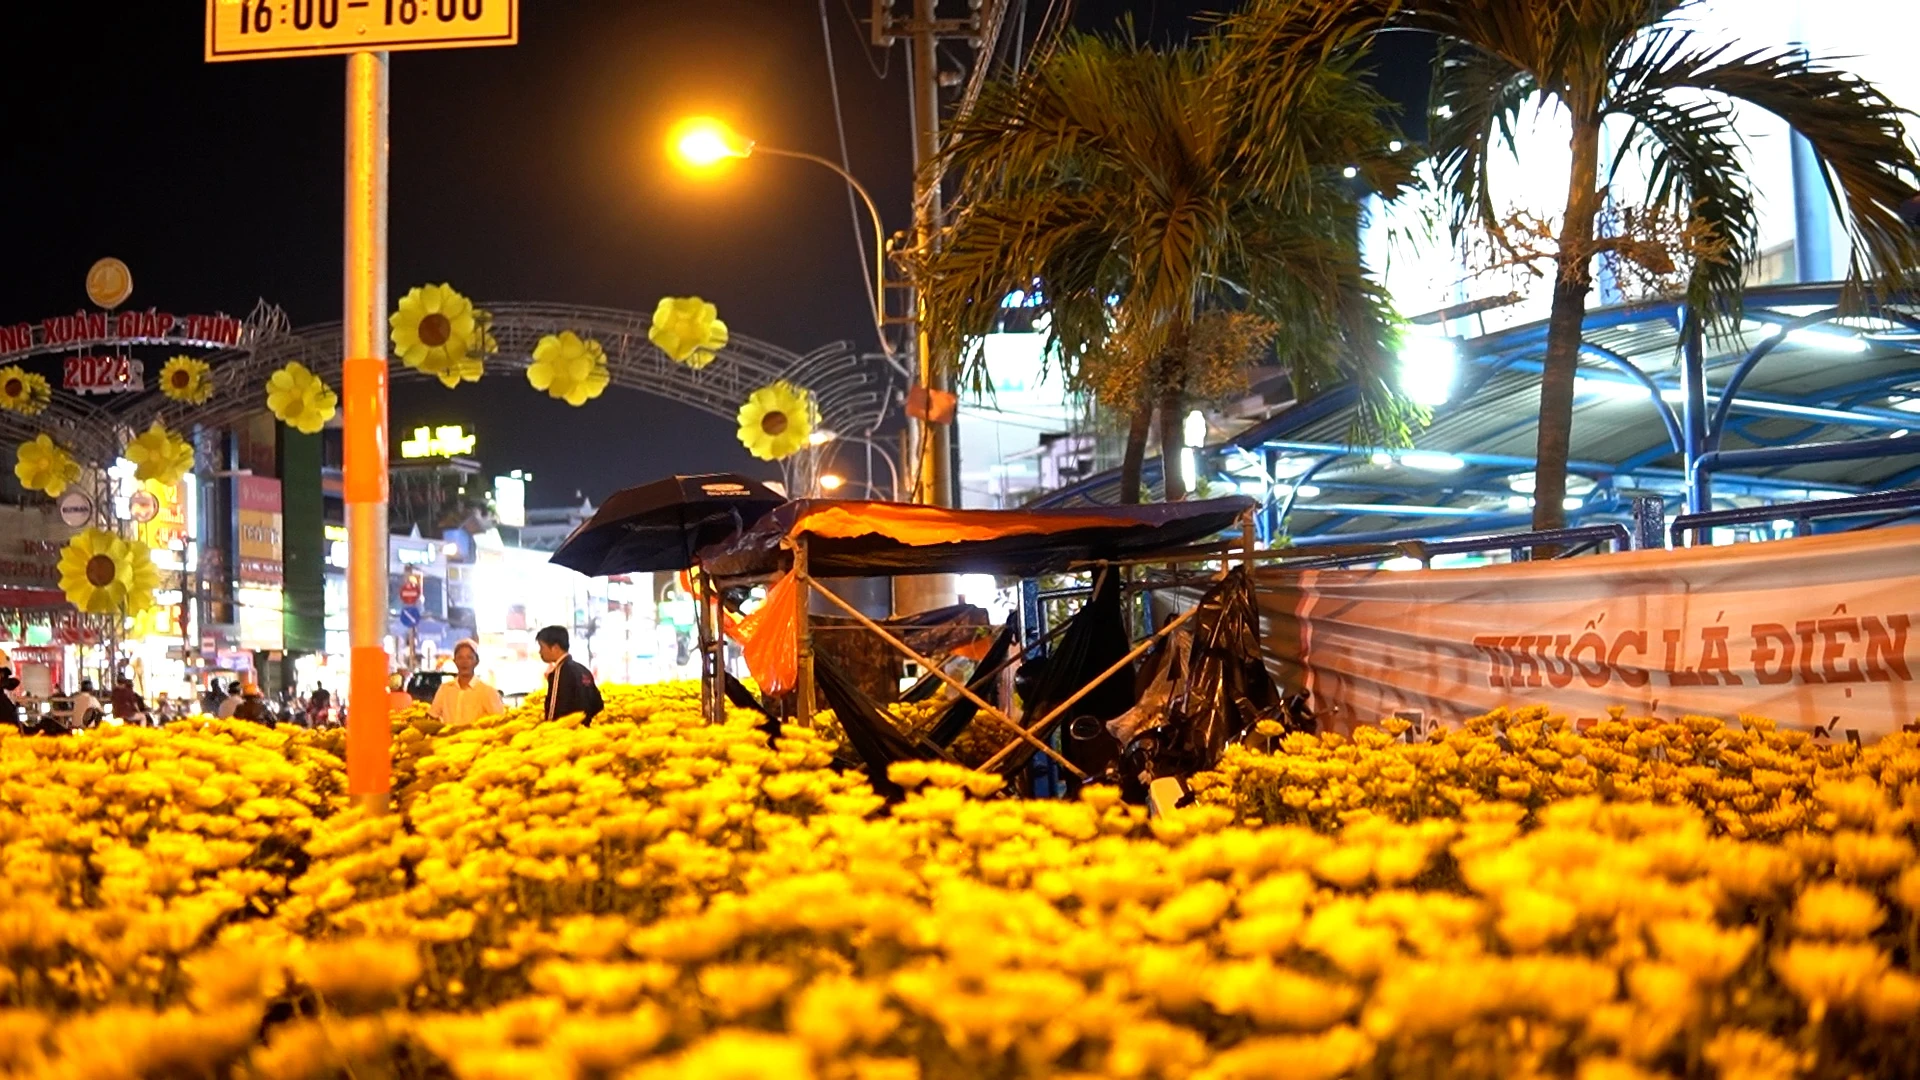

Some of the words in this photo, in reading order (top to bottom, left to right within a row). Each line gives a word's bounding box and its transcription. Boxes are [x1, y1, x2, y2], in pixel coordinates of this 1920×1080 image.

[239, 0, 338, 34] 16:00
[42, 308, 108, 345] XUÂN
[118, 306, 175, 338] GIÁP
[187, 311, 243, 347] THÌN
[64, 356, 131, 388] 2024
[1473, 612, 1649, 688] THUỐC
[1663, 610, 1743, 687] LÁ
[1750, 603, 1914, 698] ĐIỆN
